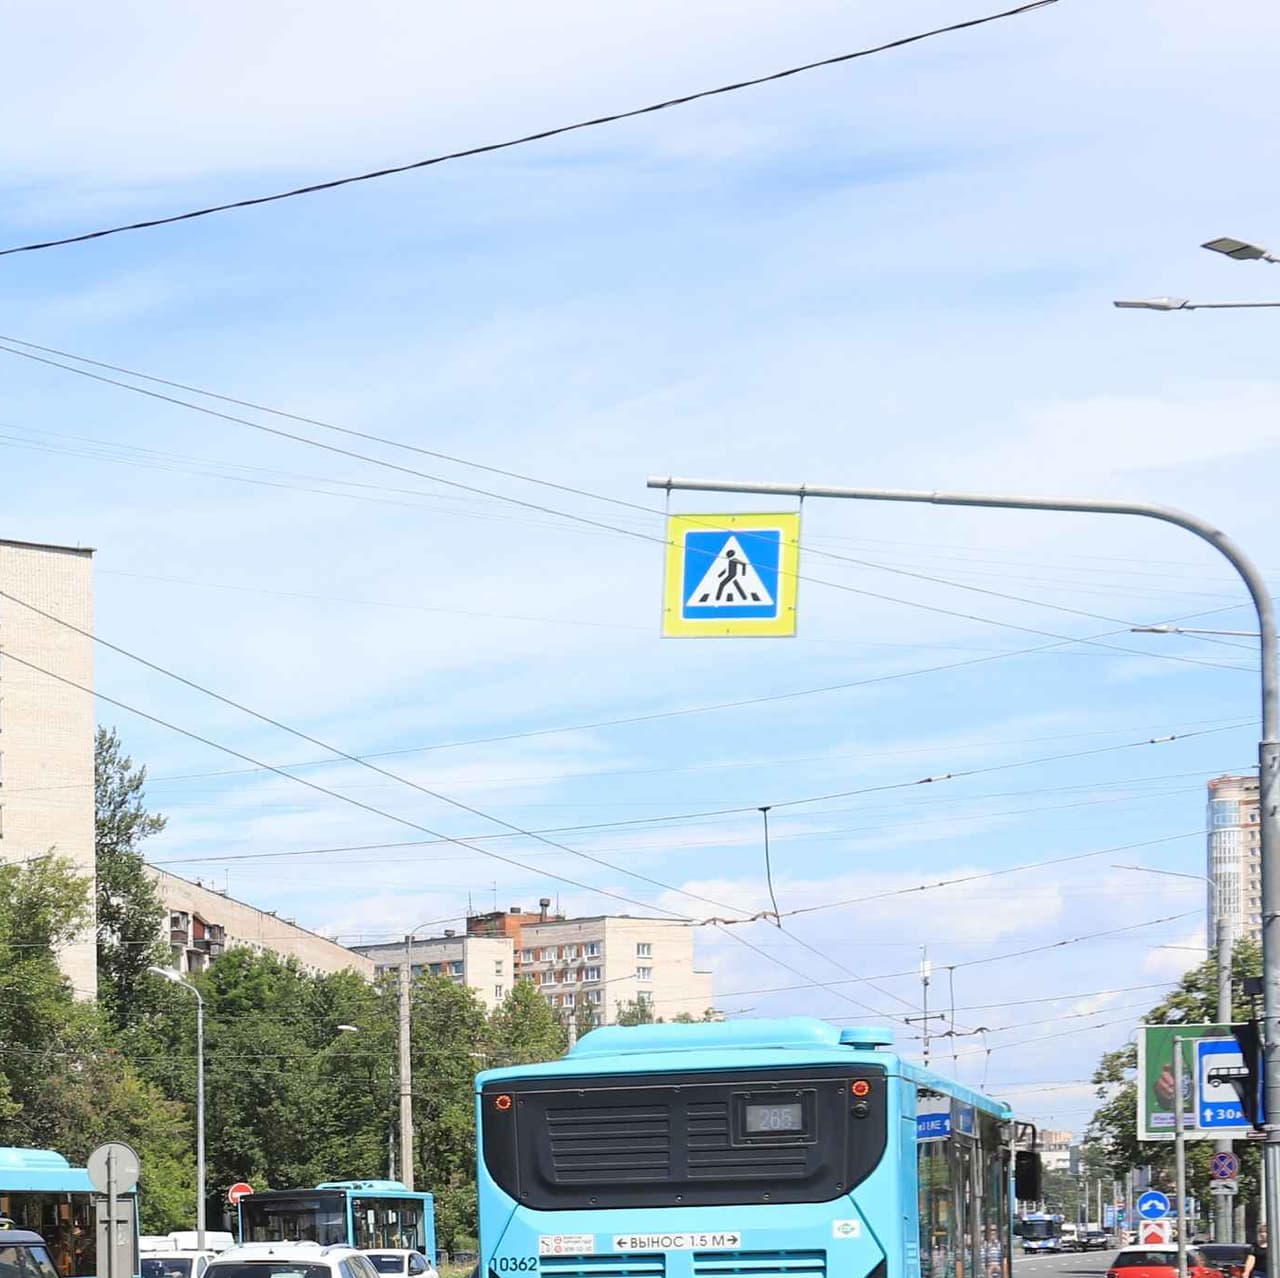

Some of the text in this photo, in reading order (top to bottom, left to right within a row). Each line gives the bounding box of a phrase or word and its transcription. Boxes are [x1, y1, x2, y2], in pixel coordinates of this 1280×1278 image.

[630, 1236, 685, 1249] ВЫНОС
[711, 1235, 725, 1247] М
[492, 1256, 538, 1272] 10362
